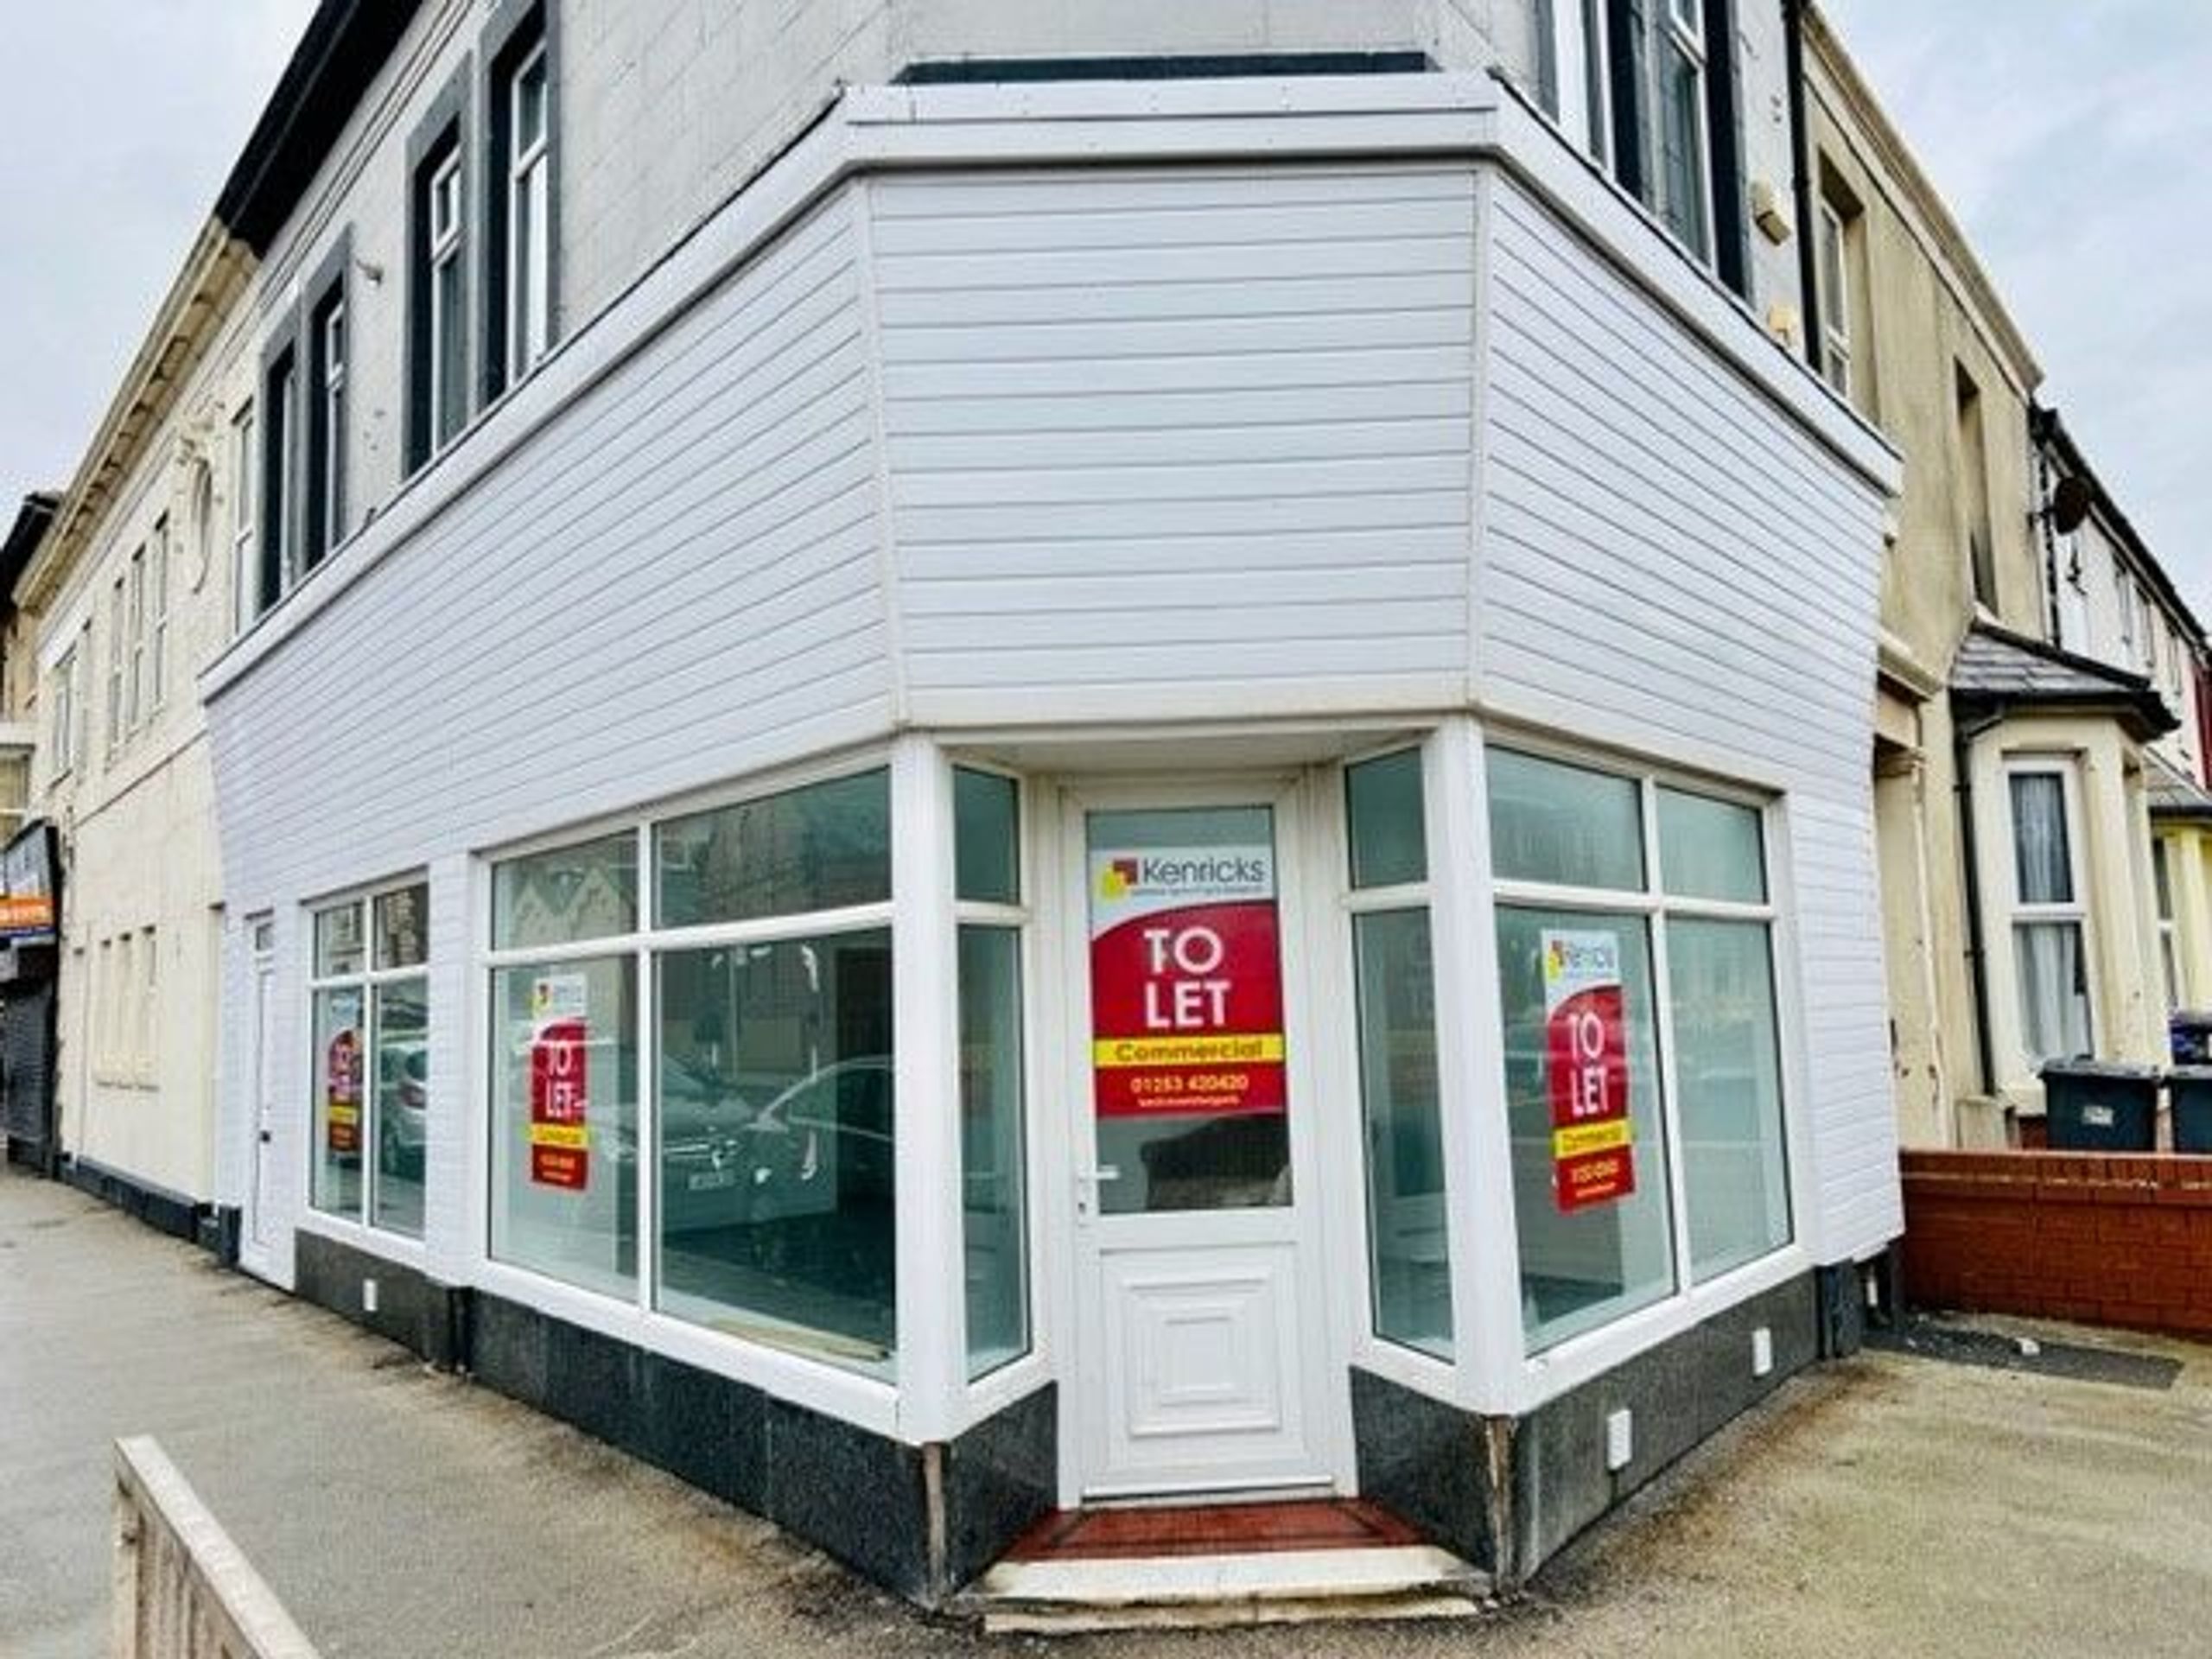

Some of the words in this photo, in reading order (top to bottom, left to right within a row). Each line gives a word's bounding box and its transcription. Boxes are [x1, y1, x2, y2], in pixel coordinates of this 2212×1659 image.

[1142, 856, 1265, 883] Kenricks
[1143, 925, 1224, 975] TO
[1145, 980, 1232, 1029] LET
[1114, 1040, 1263, 1062] Commercial
[1567, 1011, 1605, 1061] TO
[1569, 1065, 1611, 1117] LET
